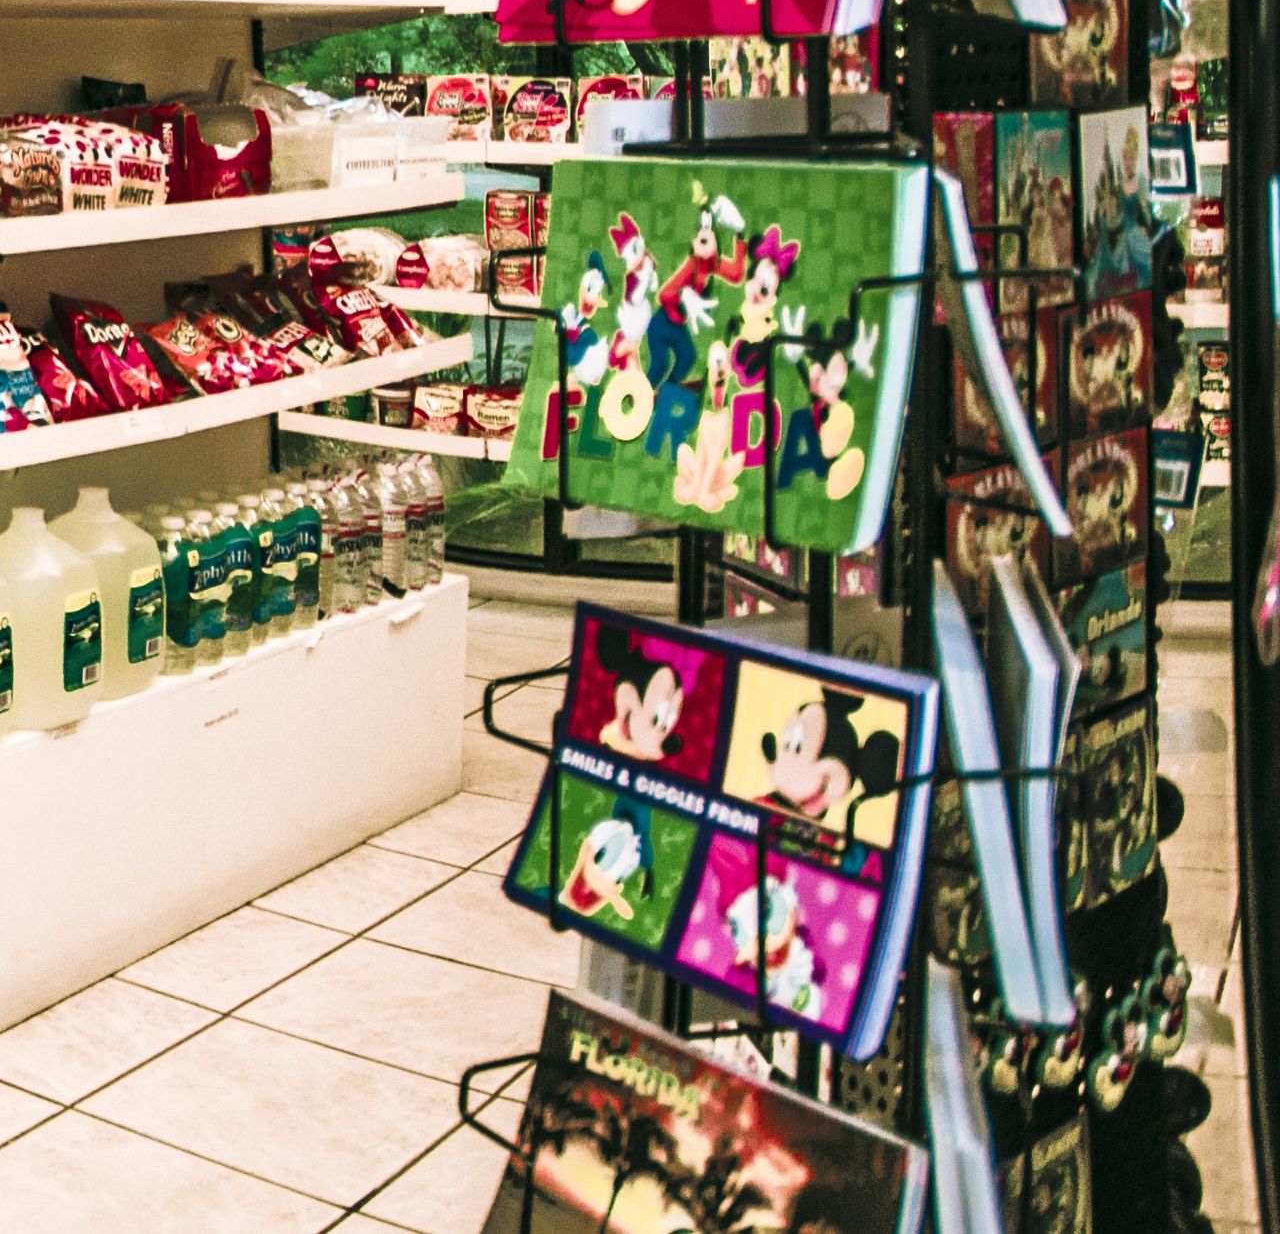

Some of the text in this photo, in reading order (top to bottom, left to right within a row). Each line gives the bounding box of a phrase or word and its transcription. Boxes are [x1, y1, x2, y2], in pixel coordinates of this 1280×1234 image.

[70, 166, 113, 187] WONDER
[118, 159, 162, 184] WONDER
[72, 193, 107, 211] WHITE
[119, 185, 154, 206] WHITE
[561, 748, 759, 835] SMILES & GIGGLES FROM
